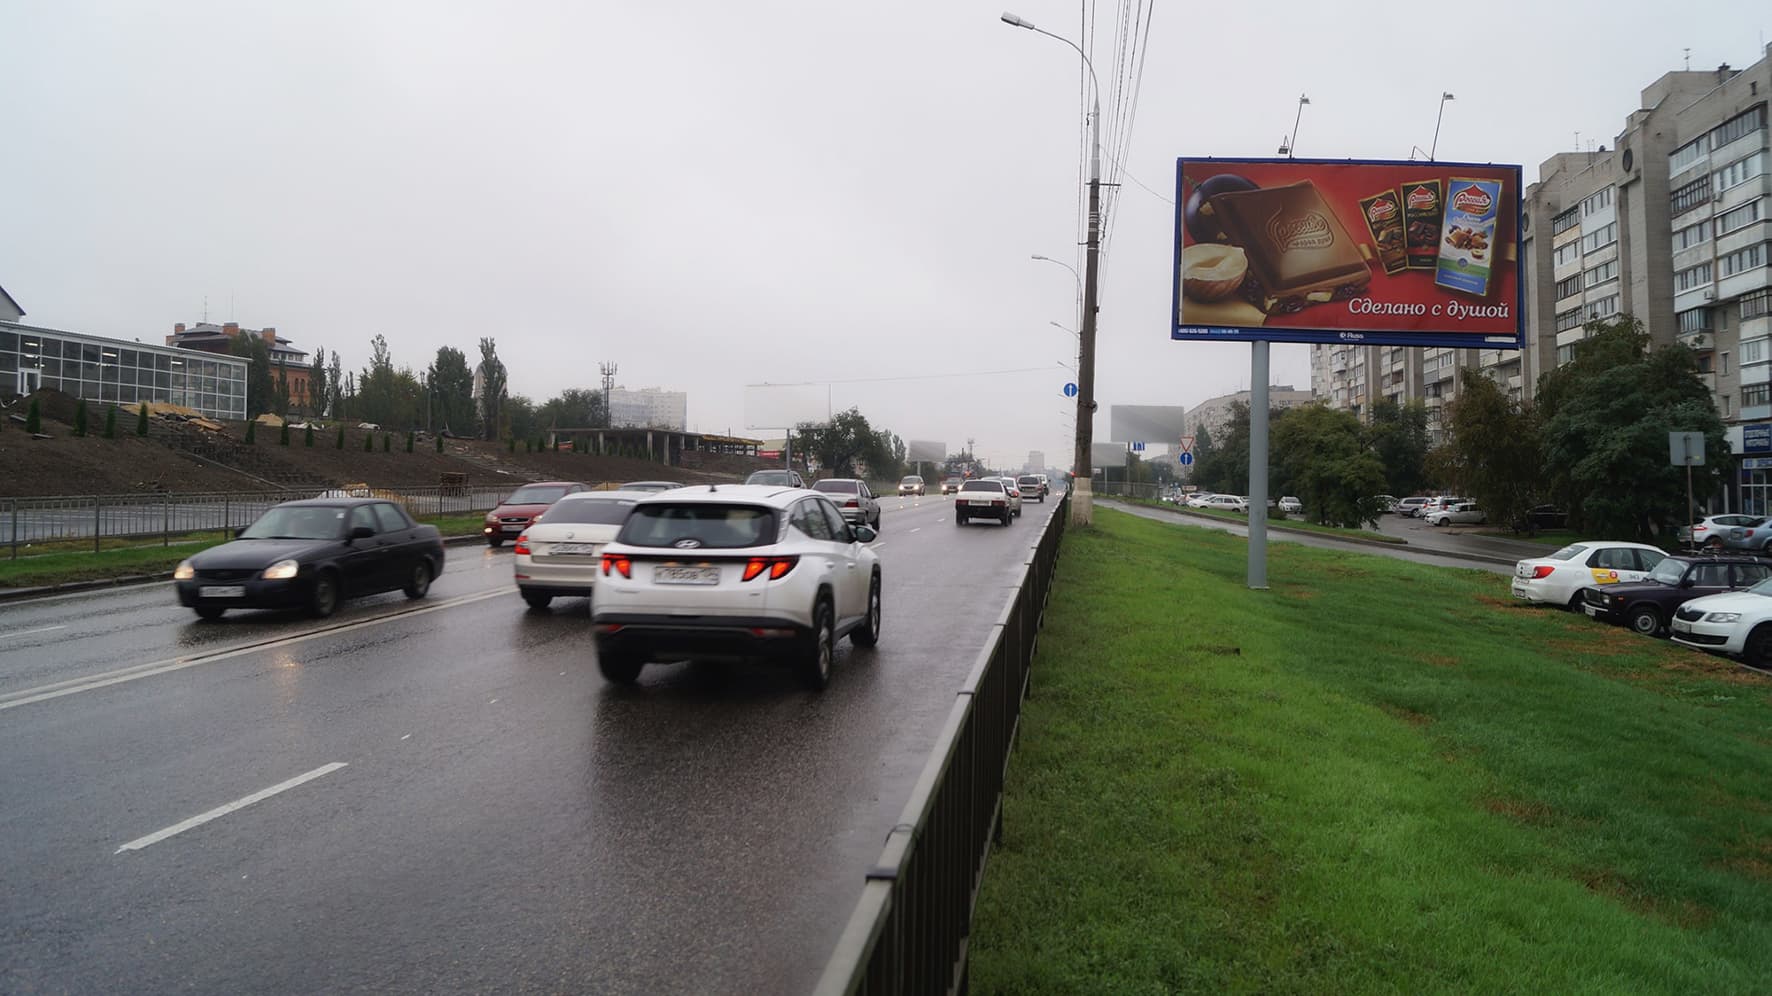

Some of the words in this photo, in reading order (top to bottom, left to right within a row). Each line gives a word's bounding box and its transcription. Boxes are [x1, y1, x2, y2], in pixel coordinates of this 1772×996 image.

[1348, 297, 1426, 316] Сделано
[1431, 303, 1442, 316] с
[1447, 300, 1509, 320] душой
